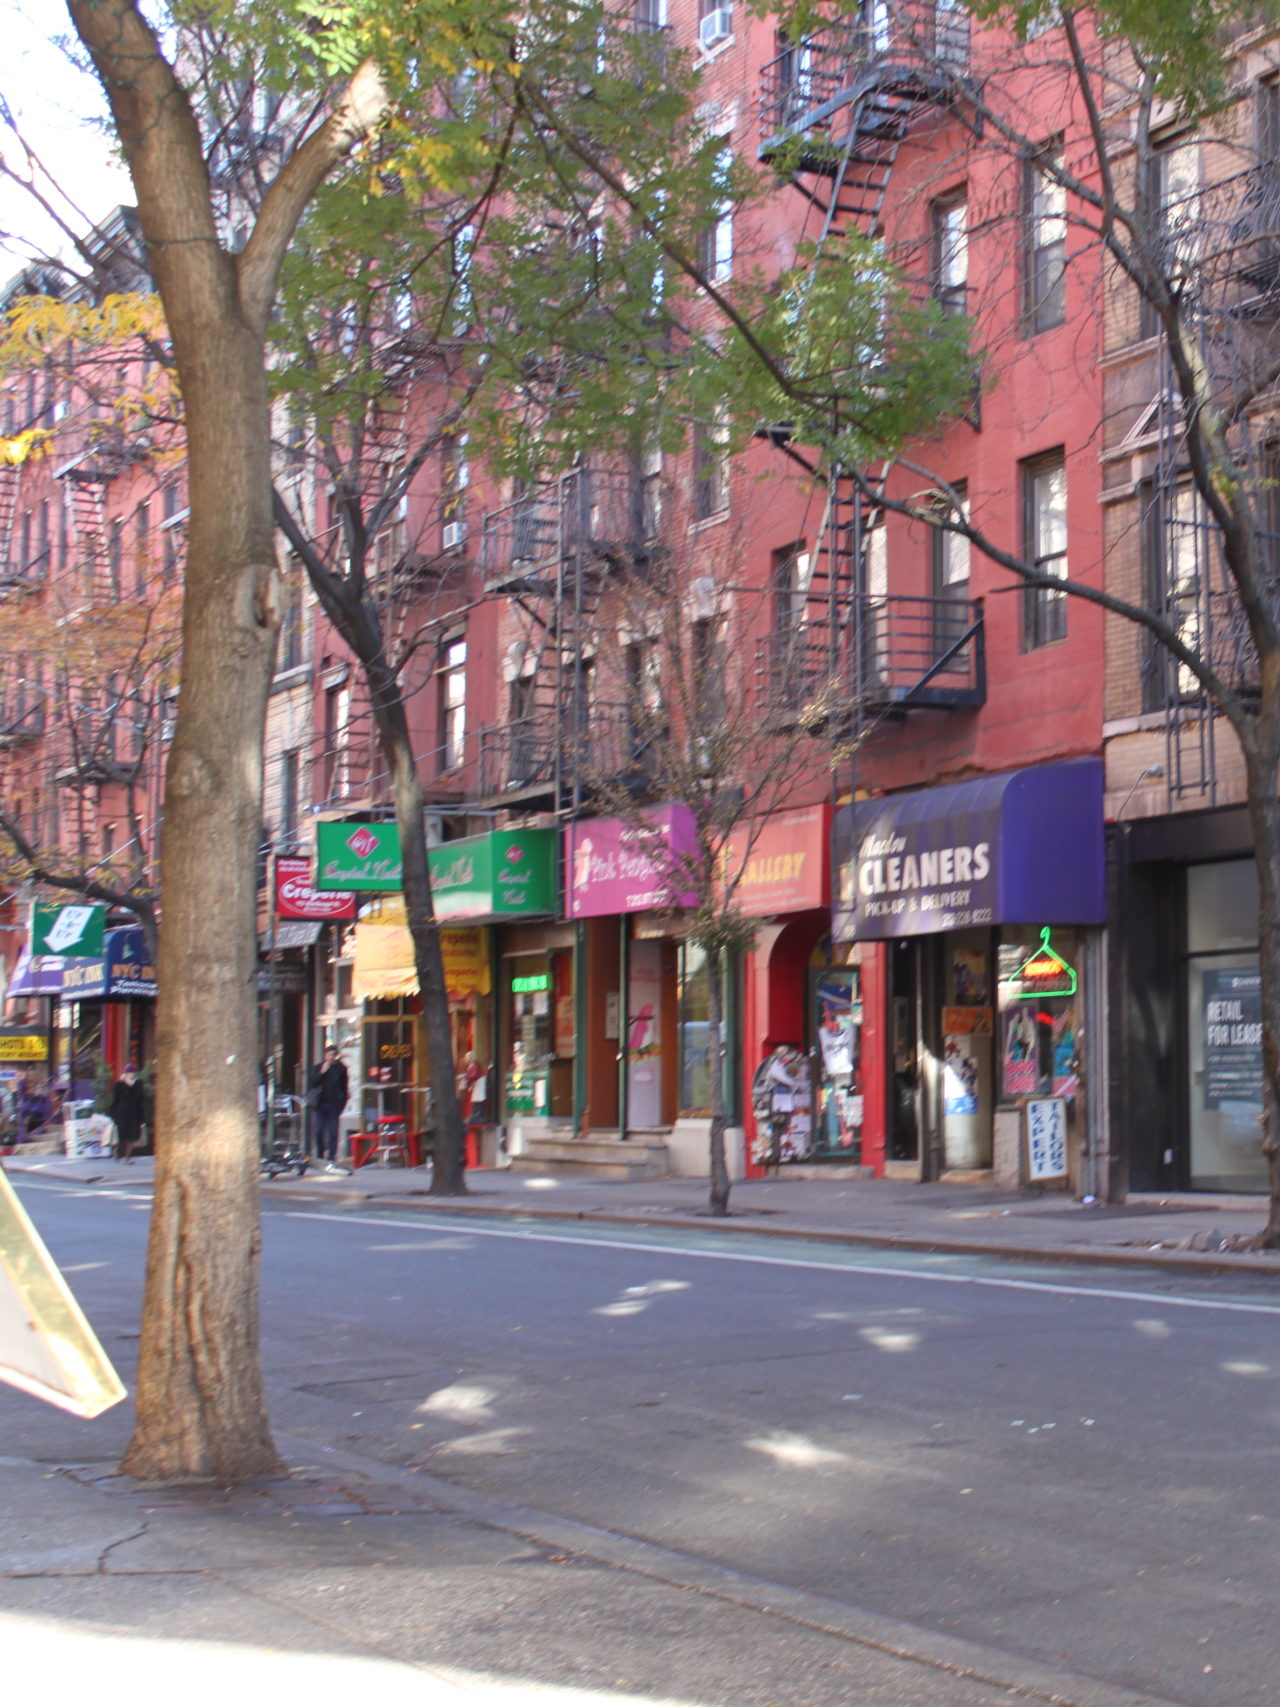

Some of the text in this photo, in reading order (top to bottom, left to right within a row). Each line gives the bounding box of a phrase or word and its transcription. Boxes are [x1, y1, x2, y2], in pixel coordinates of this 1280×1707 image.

[858, 842, 991, 896] CLEANERS
[920, 889, 972, 912] DELIVERY
[1207, 999, 1244, 1022] RETAIL
[1207, 1024, 1230, 1046] FOR
